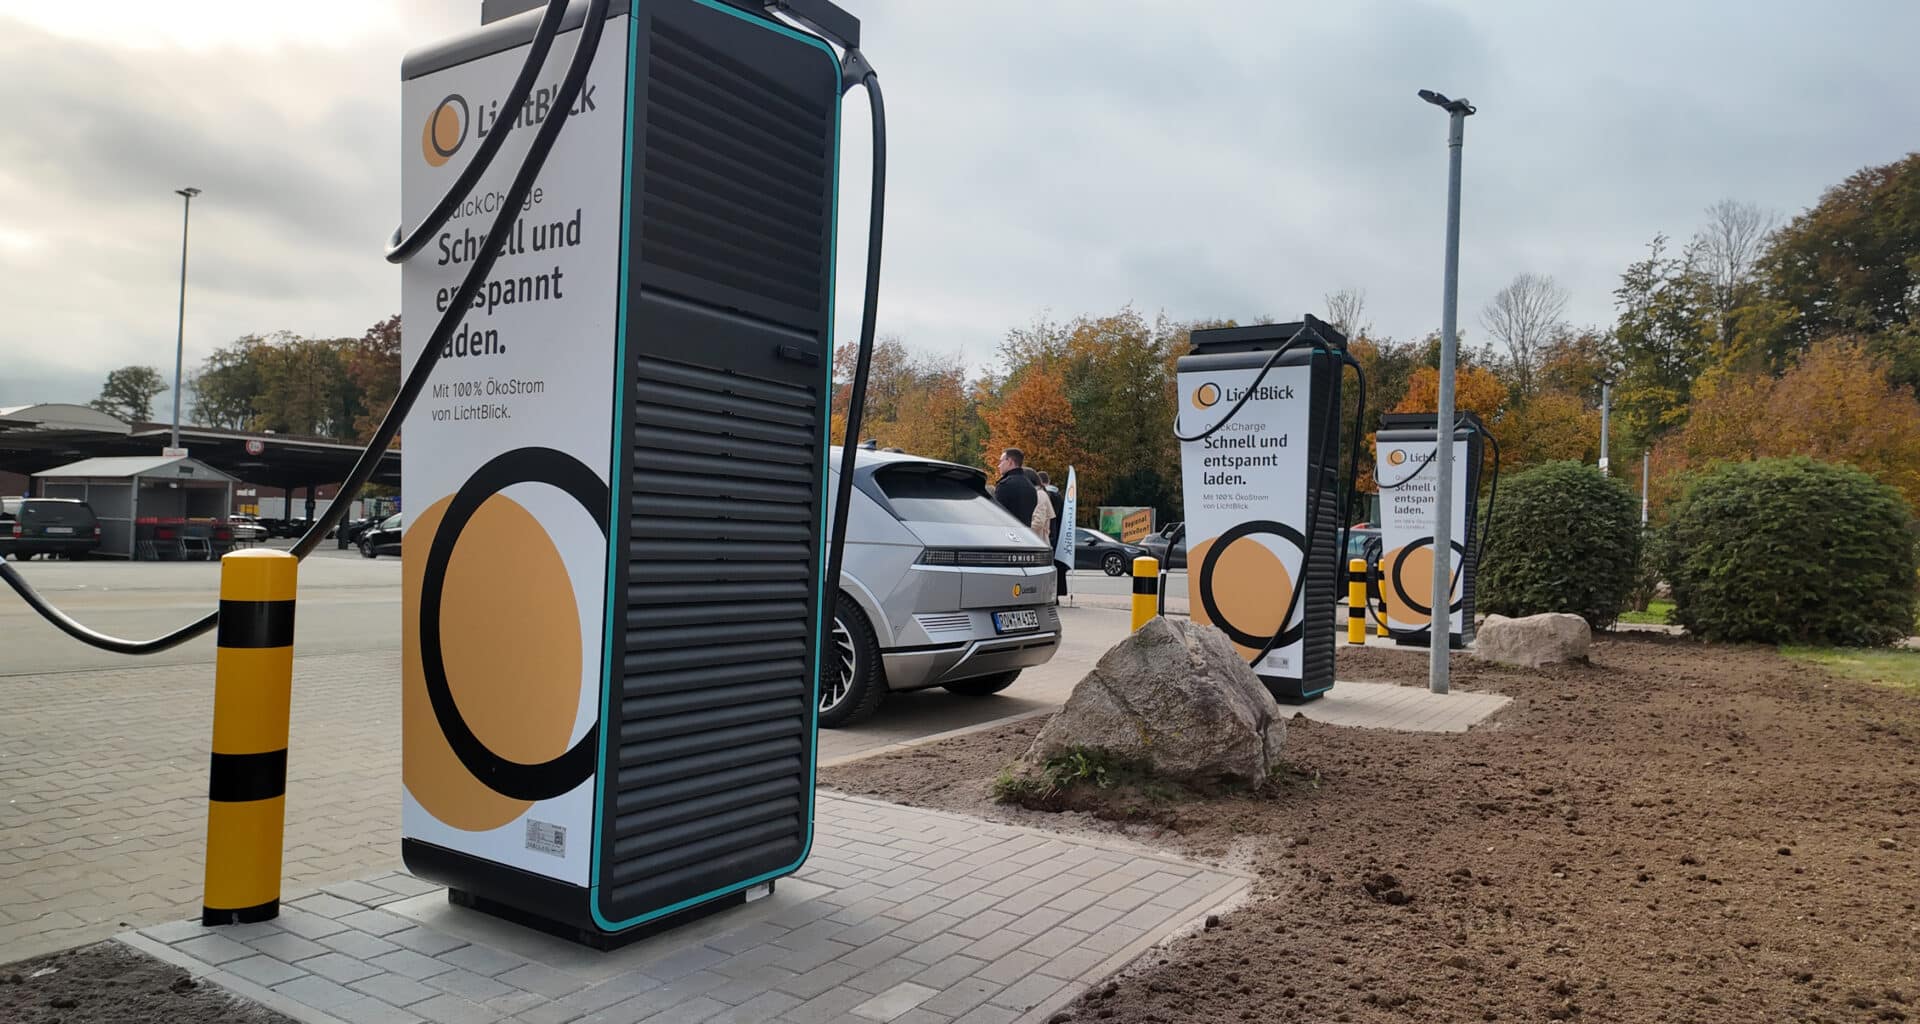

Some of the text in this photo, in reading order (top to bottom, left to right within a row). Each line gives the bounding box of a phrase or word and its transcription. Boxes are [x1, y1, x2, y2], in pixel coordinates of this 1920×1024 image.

[446, 187, 543, 221] uickChge
[438, 208, 581, 266] Schll und
[436, 265, 563, 316] espannt
[438, 322, 507, 360] aden.
[432, 376, 545, 399] Mit 100% ÖkoStrom
[432, 404, 512, 421] von LichtBlick.
[1204, 433, 1288, 449] Schnell und
[1203, 453, 1278, 470] entspannt
[1203, 471, 1247, 485] laden.
[1394, 494, 1435, 504] entspan
